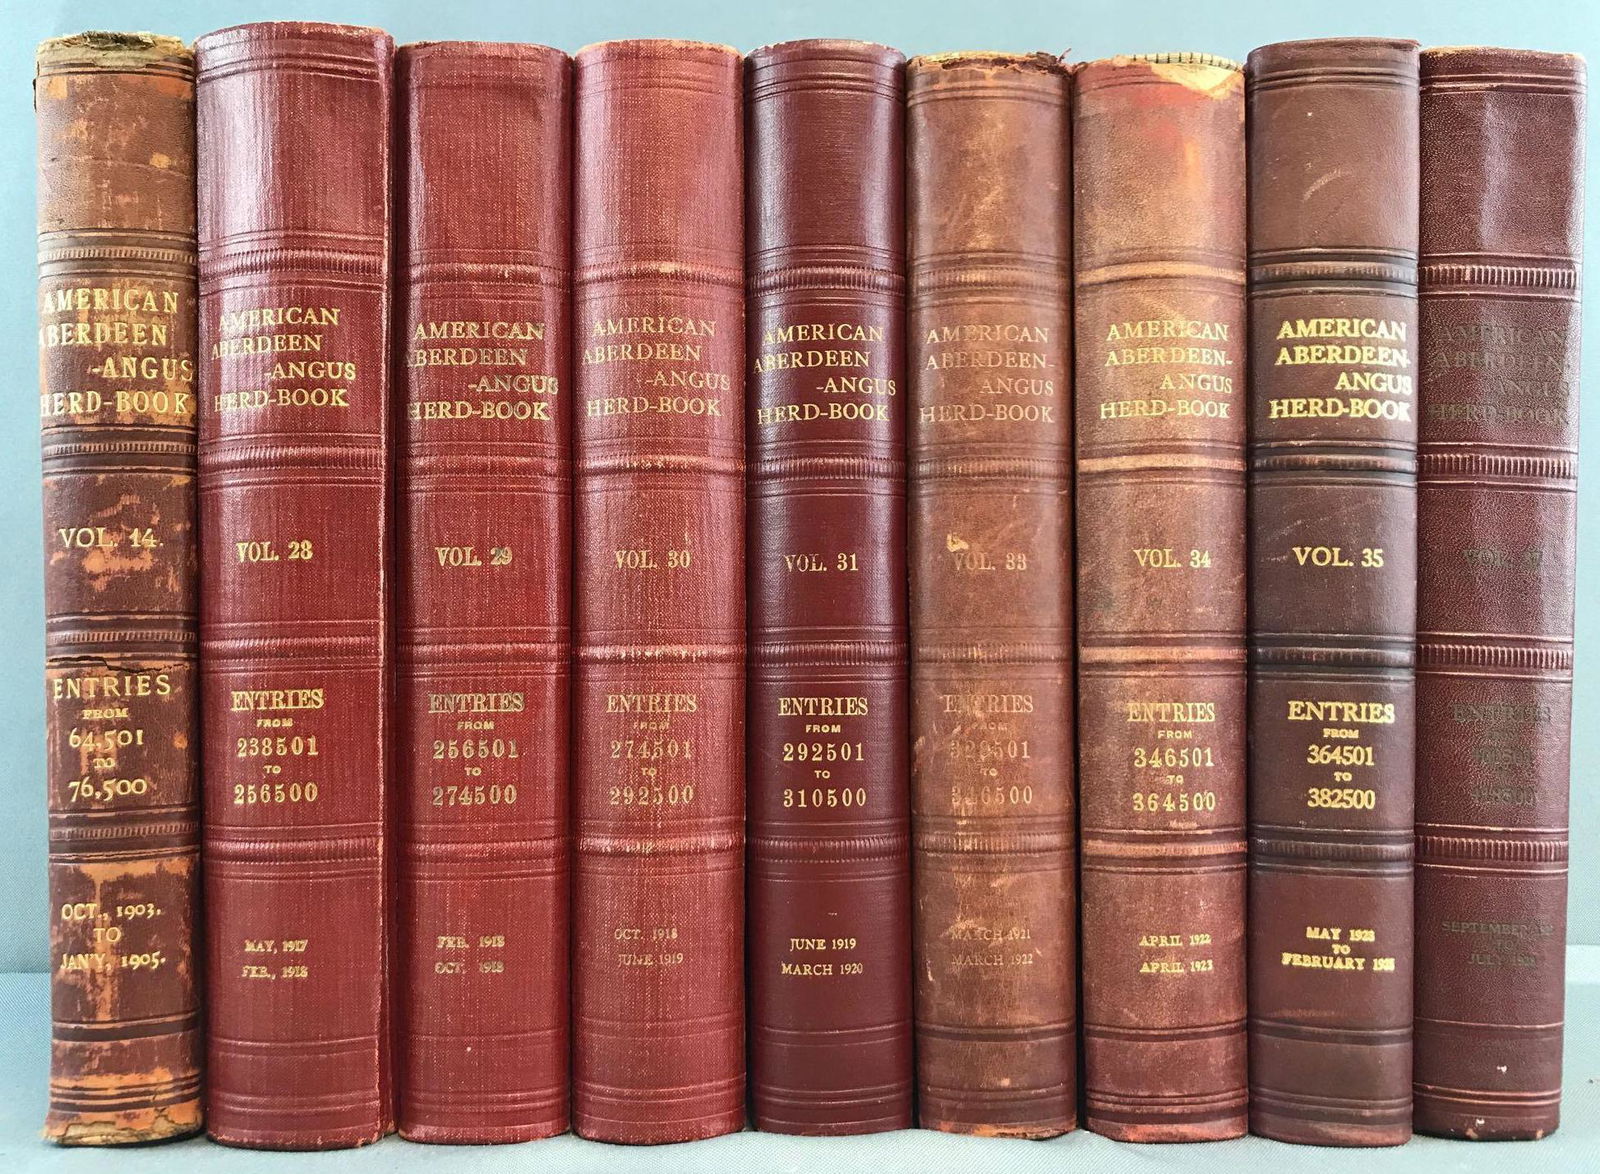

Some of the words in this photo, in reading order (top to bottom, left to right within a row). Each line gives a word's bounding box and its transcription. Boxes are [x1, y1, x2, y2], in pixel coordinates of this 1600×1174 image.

[43, 288, 179, 313] AMERICAN
[219, 306, 341, 331] AMERICAN
[592, 316, 716, 337] AMERICAN
[413, 321, 544, 340] AMERICAN
[762, 323, 884, 345] AMERICAN
[926, 325, 1050, 344] AMERICAN
[1106, 320, 1230, 341] AMERICAN
[1276, 318, 1407, 343] AMERICAN
[211, 334, 322, 360] ABERDEEN
[583, 343, 702, 364] ABERDEEN
[1104, 347, 1233, 367] ABERDEEN-
[92, 357, 193, 380] -ANGUS
[264, 362, 356, 380] -ANGUS
[754, 350, 870, 374] ABERDEEN
[468, 375, 558, 394] -ANGUS
[646, 370, 730, 391] -ANGUS
[816, 376, 896, 396] -ANGUS
[980, 378, 1054, 396] ANGUS
[1160, 373, 1232, 394] ANGUS
[1334, 372, 1413, 396] ANGUS
[40, 390, 189, 418] HERD-BOOK
[214, 388, 350, 413] HERD-BOOK
[408, 400, 551, 420] HERD-BOOK
[587, 397, 723, 417] HERD-BOOK
[1100, 399, 1230, 420] HERD-BOOK
[1268, 398, 1412, 422] HERD-BOOK
[757, 402, 890, 425] HERD-BOOK
[920, 404, 1055, 423] HERD-BOOK
[60, 527, 118, 549] VOL.
[236, 541, 280, 562] VOL.
[288, 540, 313, 560] 28
[435, 546, 482, 566] VOL.
[490, 546, 513, 566] 29
[614, 550, 657, 569] VOL.
[667, 549, 691, 569] 30
[1133, 548, 1181, 568] VOL.
[1190, 549, 1212, 569] 34
[1292, 546, 1354, 567] VOL.
[1361, 547, 1384, 568] 35
[783, 553, 828, 572] VOL.
[837, 552, 859, 571] 31
[952, 552, 996, 571] VOL.
[1005, 552, 1027, 571] 33
[53, 674, 172, 700] ENTRIES
[230, 688, 324, 712] ENTRIES
[428, 692, 525, 713] ENTRIES
[605, 694, 697, 713] ENTRIES
[778, 697, 868, 716] ENTRIES
[82, 708, 128, 720] FROM
[1127, 702, 1216, 722] ENTRIES
[1287, 700, 1396, 724] ENTRIES
[256, 718, 293, 728] FROM
[457, 720, 495, 730] FROM
[633, 721, 670, 730] FROM
[805, 724, 841, 733] FROM
[1157, 729, 1193, 739] FROM
[1323, 728, 1359, 739] FROM
[238, 736, 319, 757] 238501
[433, 738, 519, 759] 256501
[611, 740, 692, 760] 274501
[783, 742, 864, 761] 292501
[1307, 745, 1375, 767] 364501
[93, 757, 116, 768] TO
[1134, 747, 1215, 768] 346501
[263, 765, 281, 774] TO
[465, 766, 481, 776] TO
[641, 766, 657, 776] TO
[814, 769, 831, 779] TO
[1334, 772, 1353, 782] TO
[68, 776, 148, 803] 76,500
[1166, 775, 1184, 785] TO
[234, 782, 318, 805] 256500
[433, 784, 517, 806] 274500
[609, 785, 694, 805] 292500
[783, 787, 867, 808] 310500
[1132, 791, 1216, 812] 364500
[1307, 788, 1376, 810] 382500
[93, 927, 121, 943] TO
[652, 927, 678, 940] 1918
[1139, 934, 1183, 947] APRIL
[1189, 933, 1212, 946] 1922
[1306, 926, 1341, 940] MAY
[244, 939, 278, 954] MAY,
[790, 938, 826, 952] JUNE
[832, 937, 857, 950] 1919
[1332, 943, 1351, 955] TO
[659, 952, 683, 965] 1919
[781, 962, 833, 976] MARCH
[840, 961, 863, 975] 1920
[952, 954, 1004, 966] MARCH
[1010, 953, 1033, 965] 1922
[1139, 961, 1184, 973] APRIL
[1189, 960, 1213, 973] 1923
[1280, 952, 1366, 971] FEBRUARY
